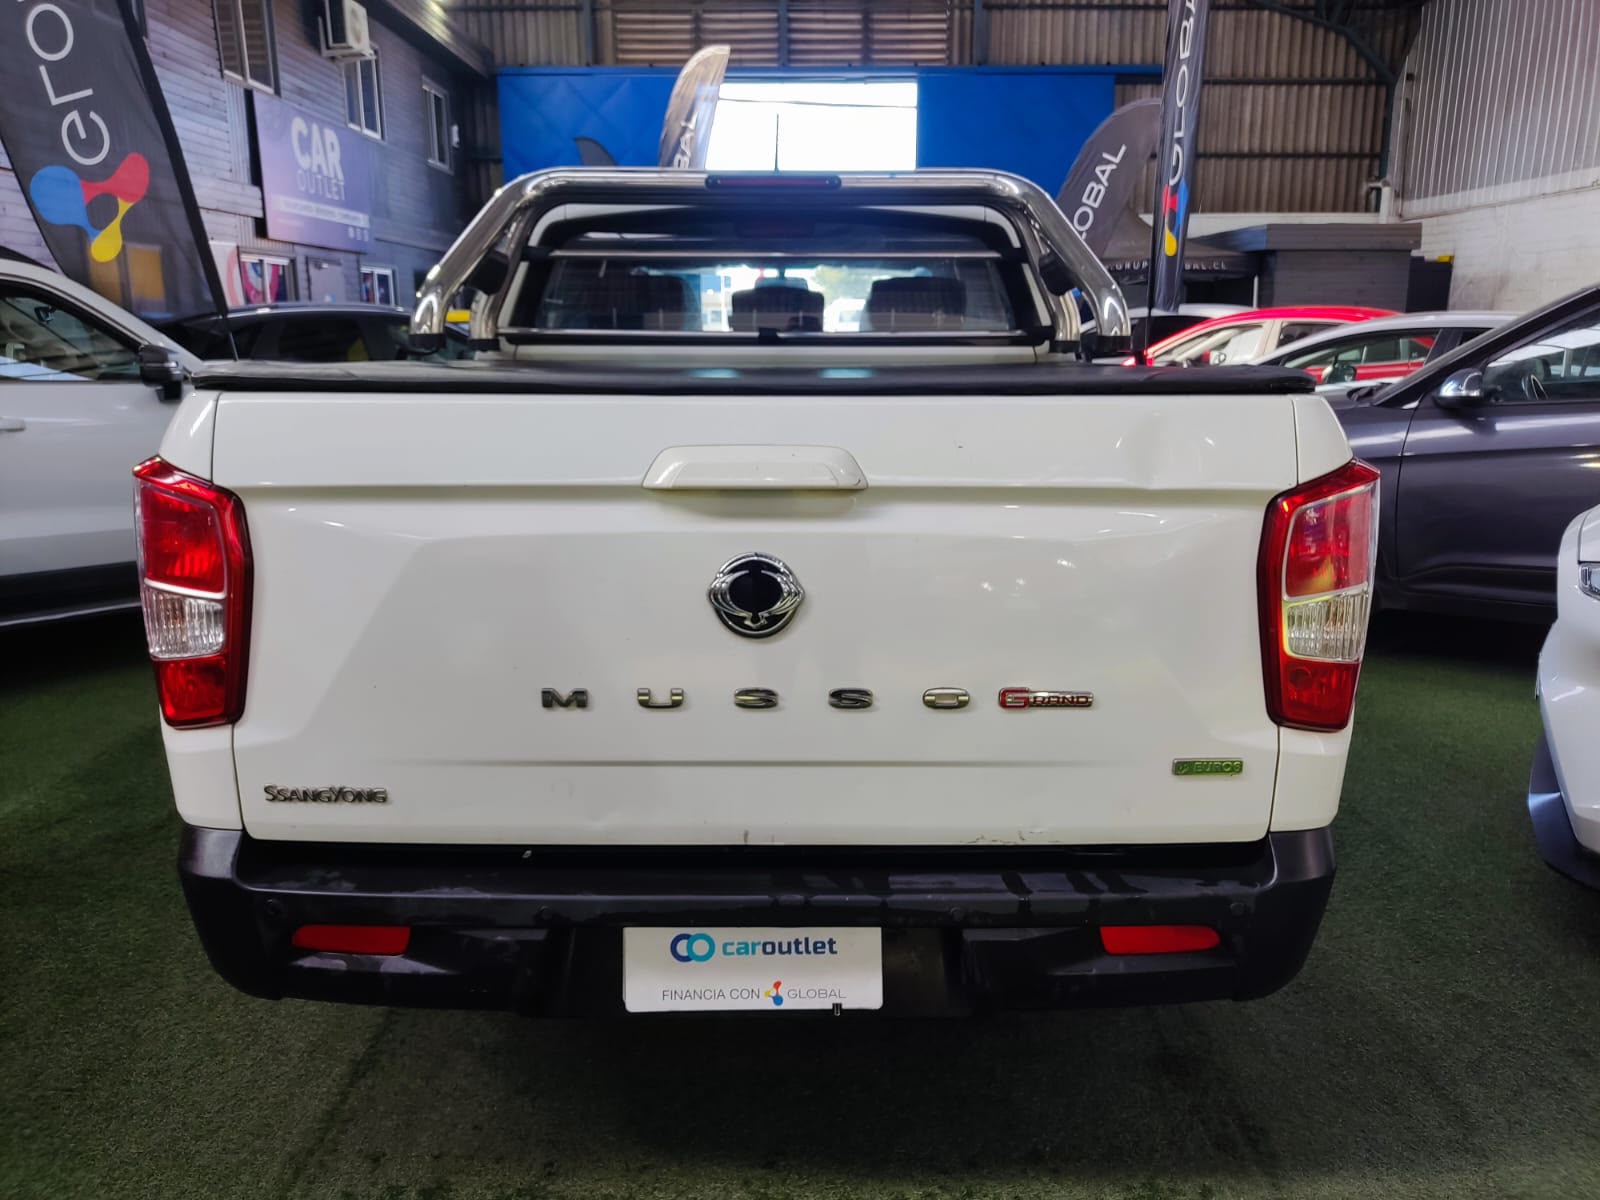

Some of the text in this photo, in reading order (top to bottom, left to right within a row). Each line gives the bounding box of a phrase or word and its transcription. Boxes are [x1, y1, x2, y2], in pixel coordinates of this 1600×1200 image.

[291, 116, 345, 181] CAR
[297, 169, 345, 201] OUTLET
[541, 687, 1093, 709] MUSSO GRAND
[721, 936, 838, 957] caroutlet
[661, 987, 847, 1001] FINANCIA CON GLOBAL
